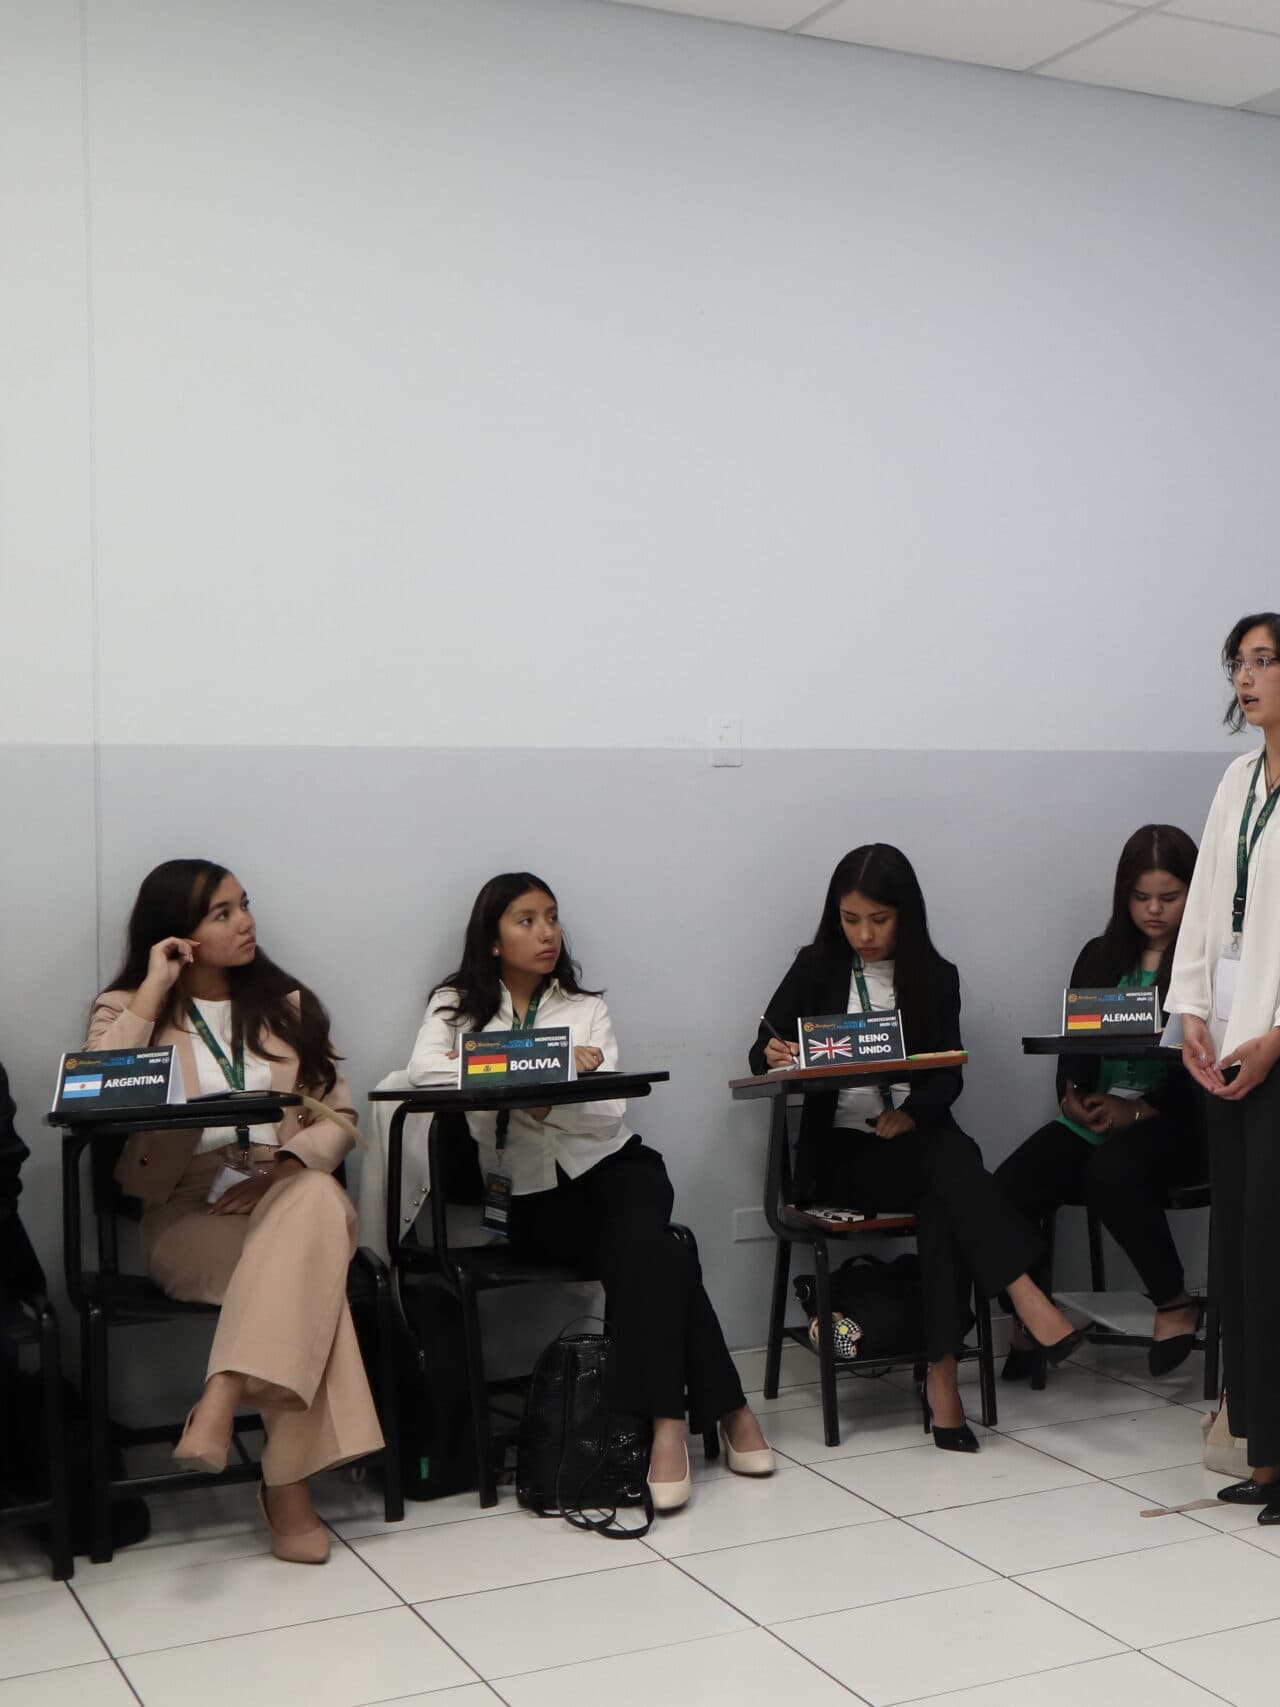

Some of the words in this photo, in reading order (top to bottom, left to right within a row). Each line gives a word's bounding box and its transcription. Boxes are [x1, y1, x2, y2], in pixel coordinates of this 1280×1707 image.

[1102, 1012, 1153, 1022] ALEMANIA
[858, 1033, 889, 1043] REINO
[859, 1044, 892, 1055] UNIDO
[510, 1057, 561, 1072] BOLIVIA
[104, 1074, 165, 1089] ARGENTINA
